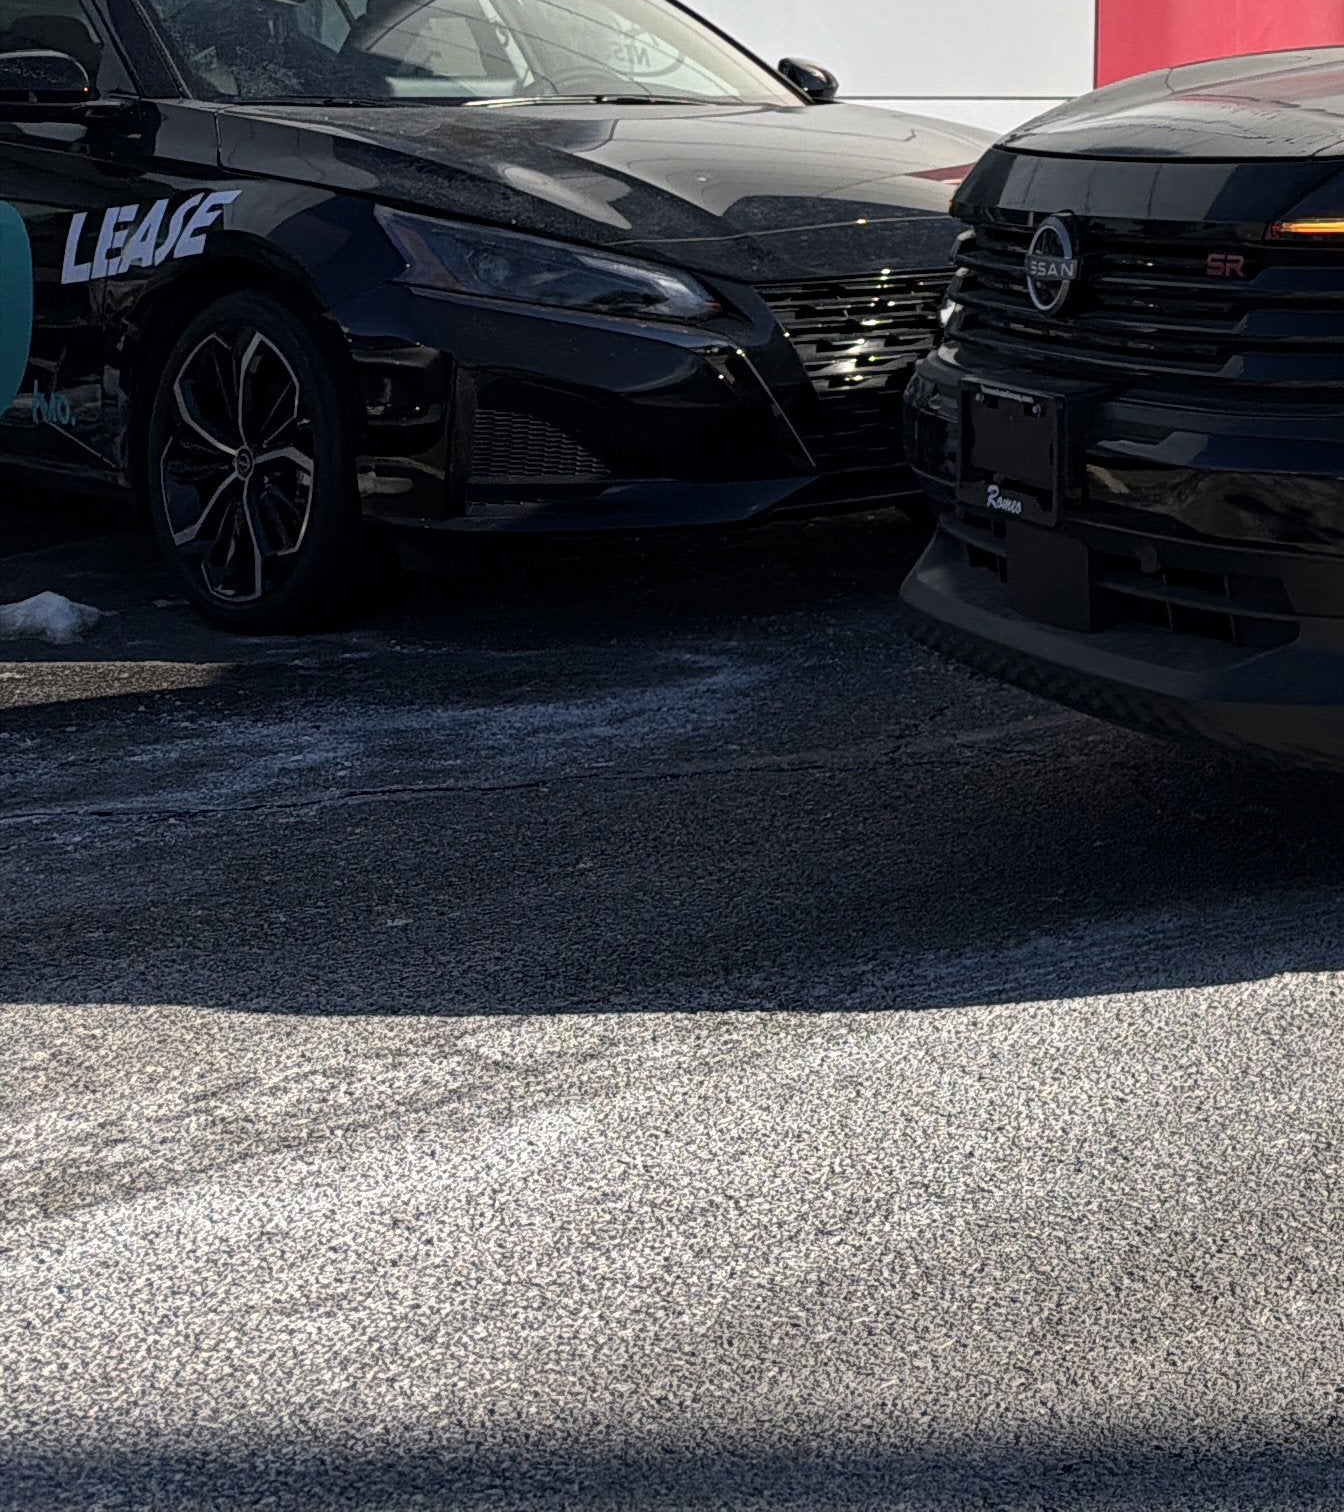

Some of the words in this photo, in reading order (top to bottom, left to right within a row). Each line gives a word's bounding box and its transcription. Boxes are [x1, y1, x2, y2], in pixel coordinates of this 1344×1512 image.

[61, 190, 242, 284] LEASE
[1206, 254, 1245, 277] SR
[987, 485, 1023, 514] Romeo
